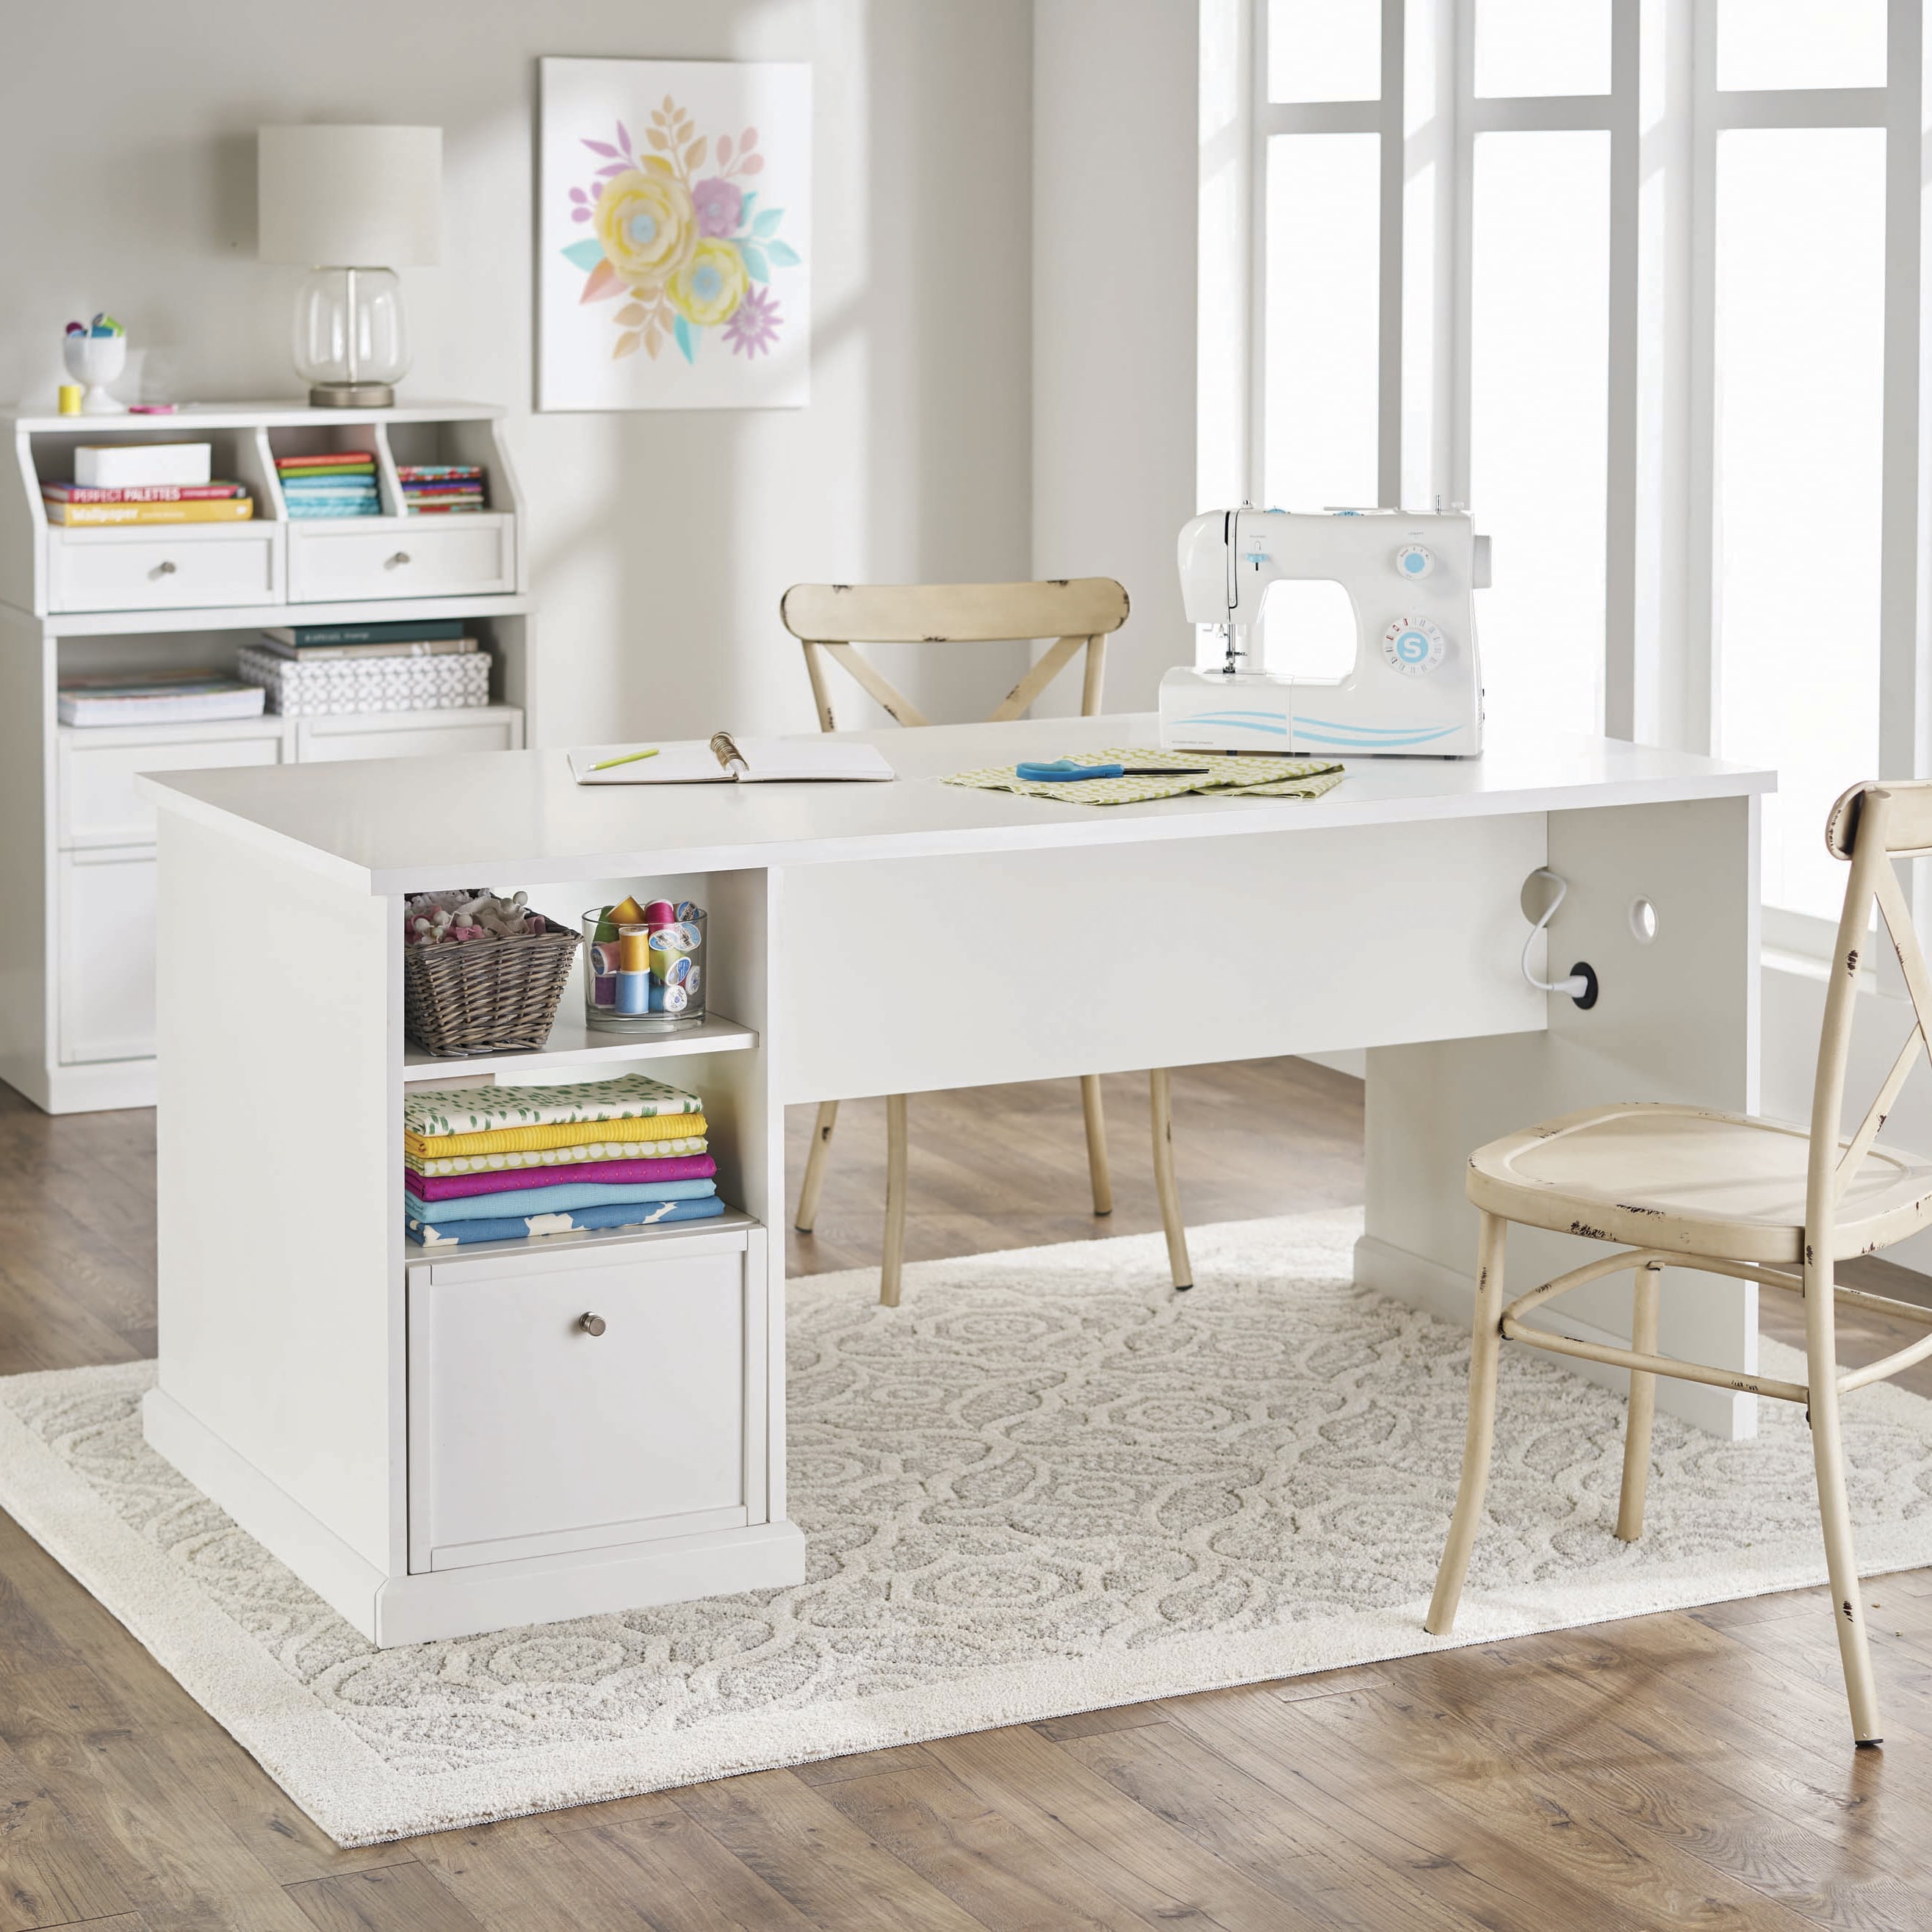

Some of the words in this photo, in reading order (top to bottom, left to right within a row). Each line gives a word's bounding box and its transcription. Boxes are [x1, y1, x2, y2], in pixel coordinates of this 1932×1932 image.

[74, 488, 121, 502] PERFECT
[123, 486, 181, 502] PALETTES
[71, 507, 139, 523] Wallpaper
[1404, 638, 1422, 658] S
